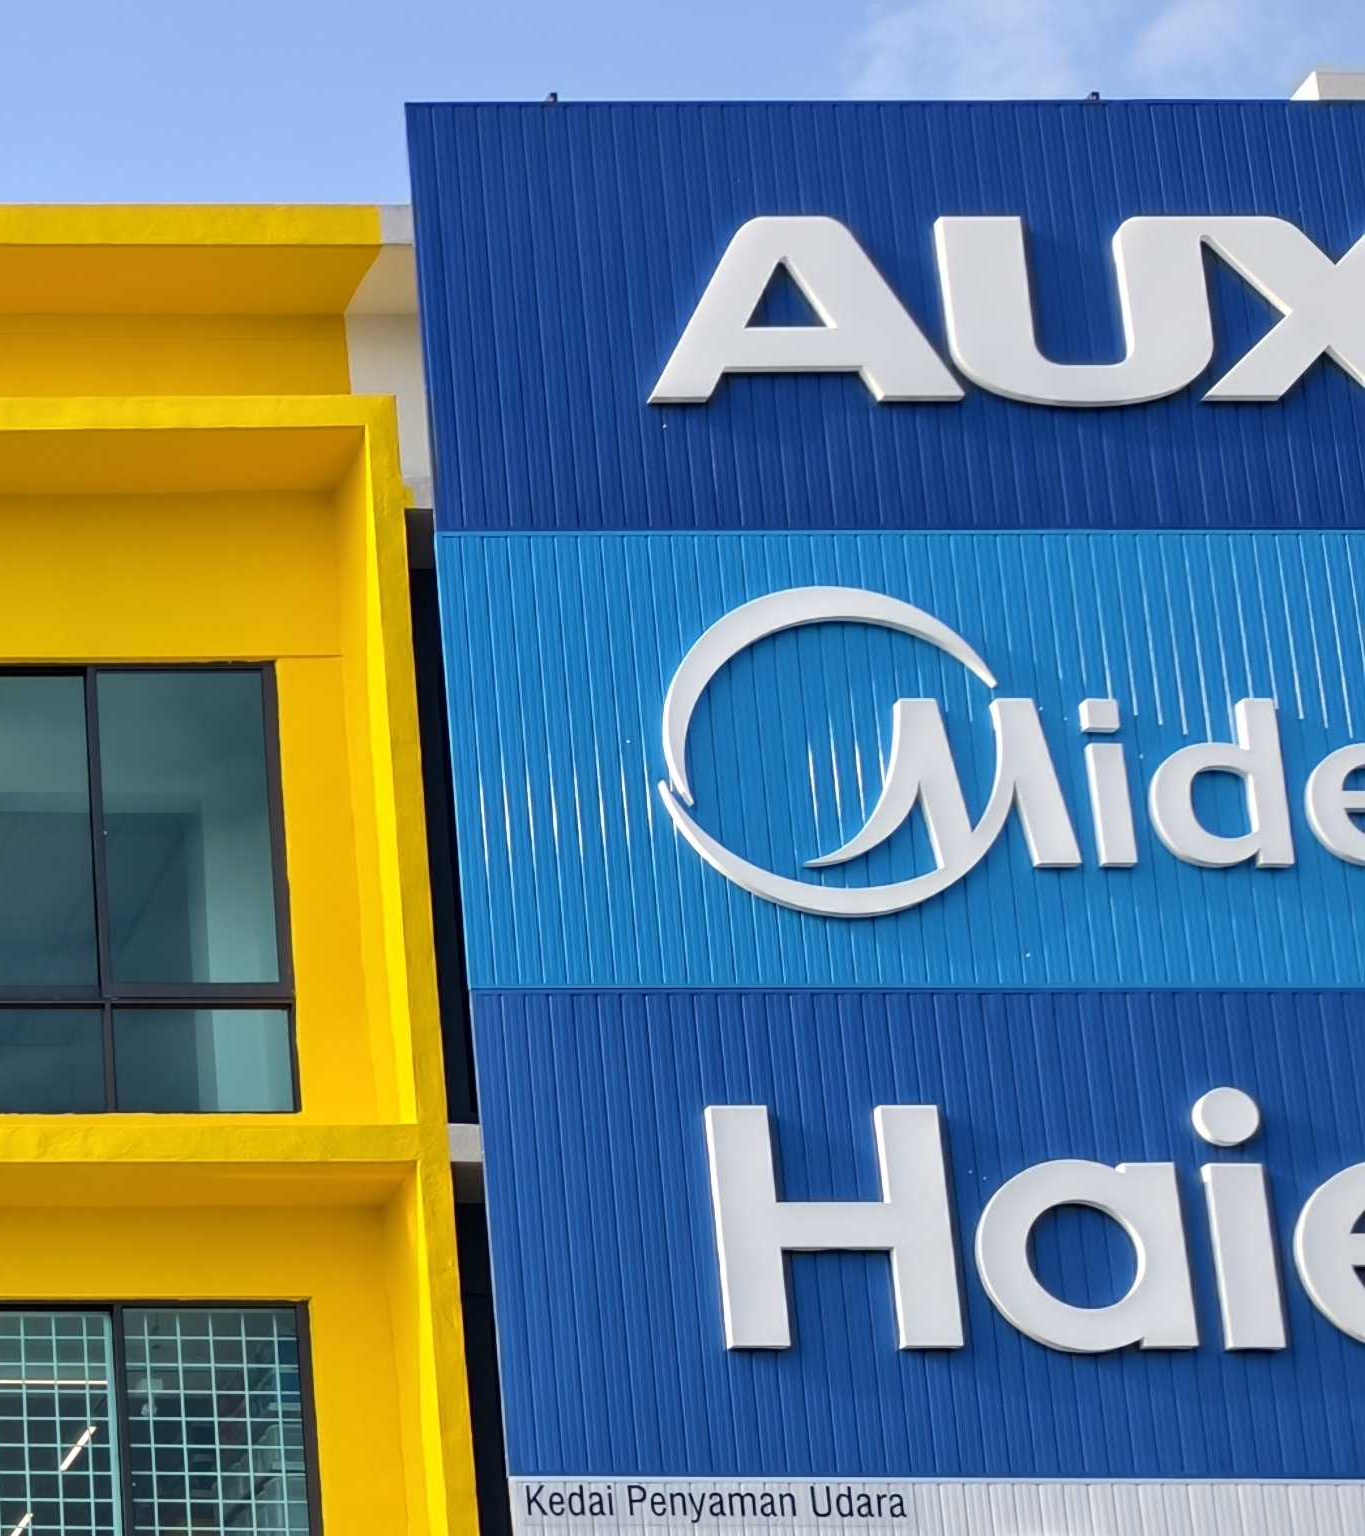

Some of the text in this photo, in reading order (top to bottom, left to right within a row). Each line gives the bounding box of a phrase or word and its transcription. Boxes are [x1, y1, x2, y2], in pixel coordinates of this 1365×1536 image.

[647, 215, 1365, 408] AUX
[525, 1484, 908, 1524] Kedai Penyaman Udara
